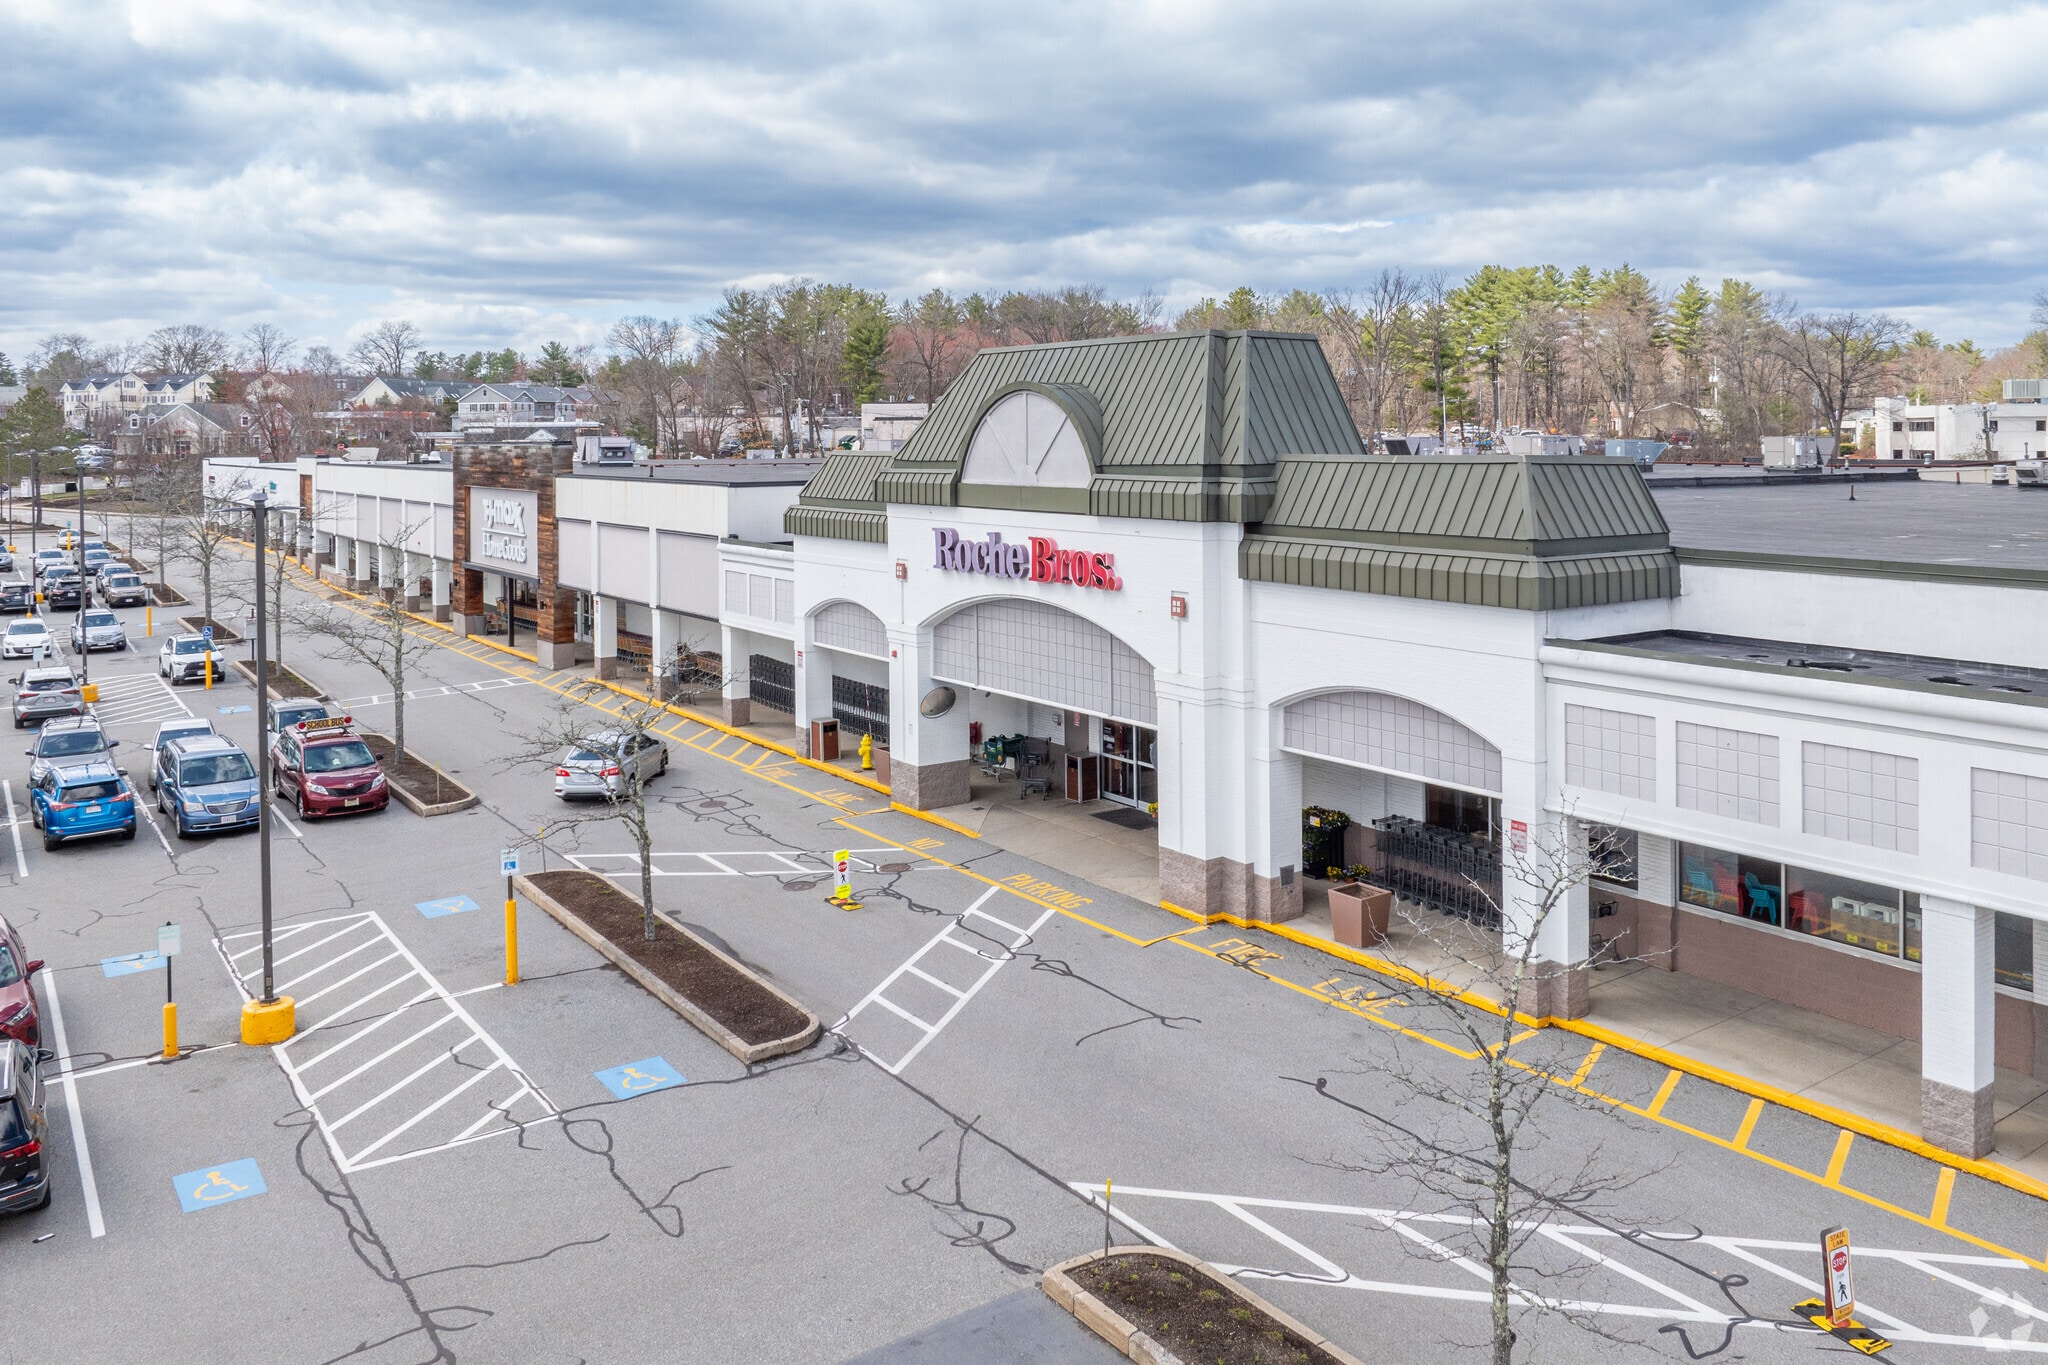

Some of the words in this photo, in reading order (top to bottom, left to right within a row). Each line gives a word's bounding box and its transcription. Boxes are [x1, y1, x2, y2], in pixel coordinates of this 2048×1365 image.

[482, 533, 527, 563] HomeGoods
[932, 527, 1029, 579] Roche
[1028, 536, 1123, 591] Bros.
[306, 719, 331, 729] SCHOOL
[331, 717, 344, 726] BUS
[999, 873, 1094, 909] PARKING
[1208, 937, 1285, 967] FIRE
[1830, 1230, 1845, 1242] STATE
[1832, 1239, 1844, 1248] LAW
[1832, 1255, 1847, 1268] STOP
